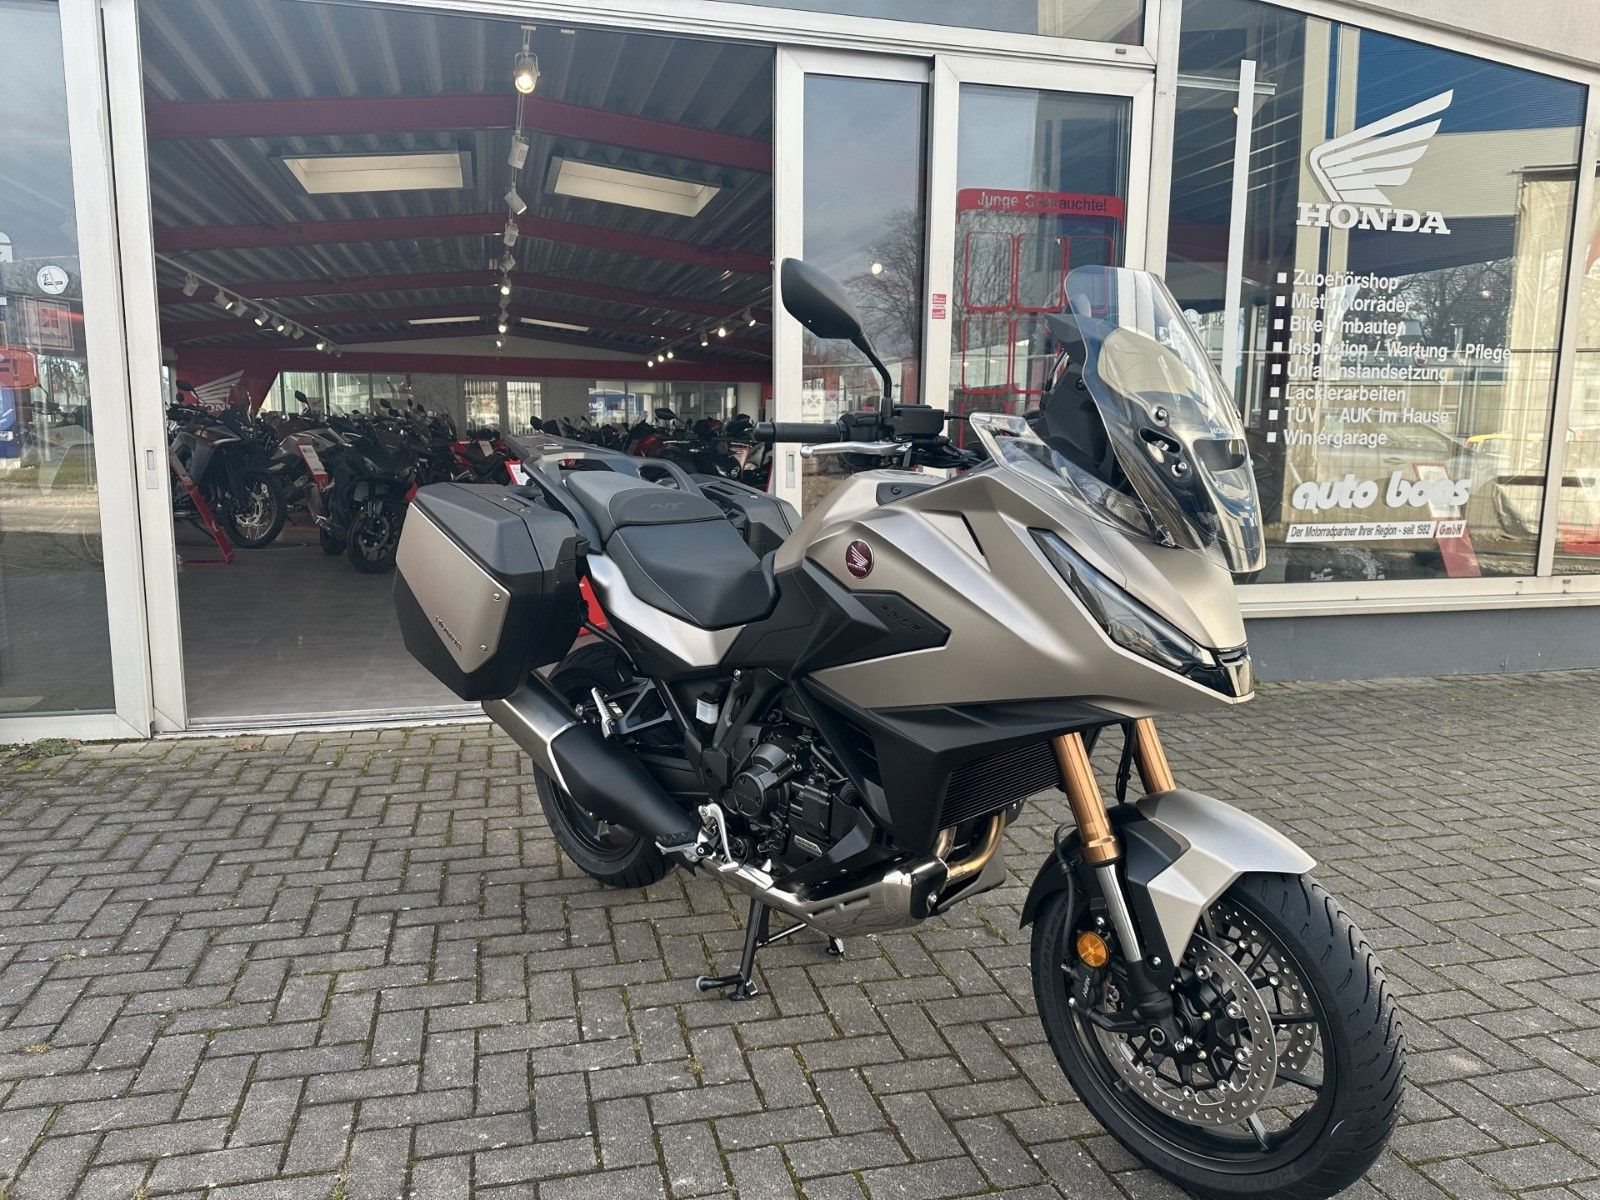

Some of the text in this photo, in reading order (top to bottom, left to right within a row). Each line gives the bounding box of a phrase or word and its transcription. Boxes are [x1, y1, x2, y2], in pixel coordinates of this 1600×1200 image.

[977, 192, 1020, 209] Junge
[1296, 202, 1451, 235] HONDA
[1293, 268, 1399, 293] Zubehörshop
[1292, 292, 1410, 312] Miettorräder
[1386, 341, 1448, 362] Wartung
[1465, 343, 1512, 364] Pflege
[1287, 362, 1449, 382] Unfanstandsetzung
[1285, 383, 1406, 402] Lackierarbeiten
[1285, 403, 1318, 423] TÜV
[1340, 408, 1373, 423] AUK
[1403, 408, 1449, 424] Hause
[1283, 429, 1388, 448] Wintergarage
[1292, 474, 1379, 510] auto
[1290, 526, 1304, 538] Der
[1305, 525, 1357, 539] Motorradpartner
[1374, 525, 1397, 538] Region
[1402, 524, 1415, 536] seit
